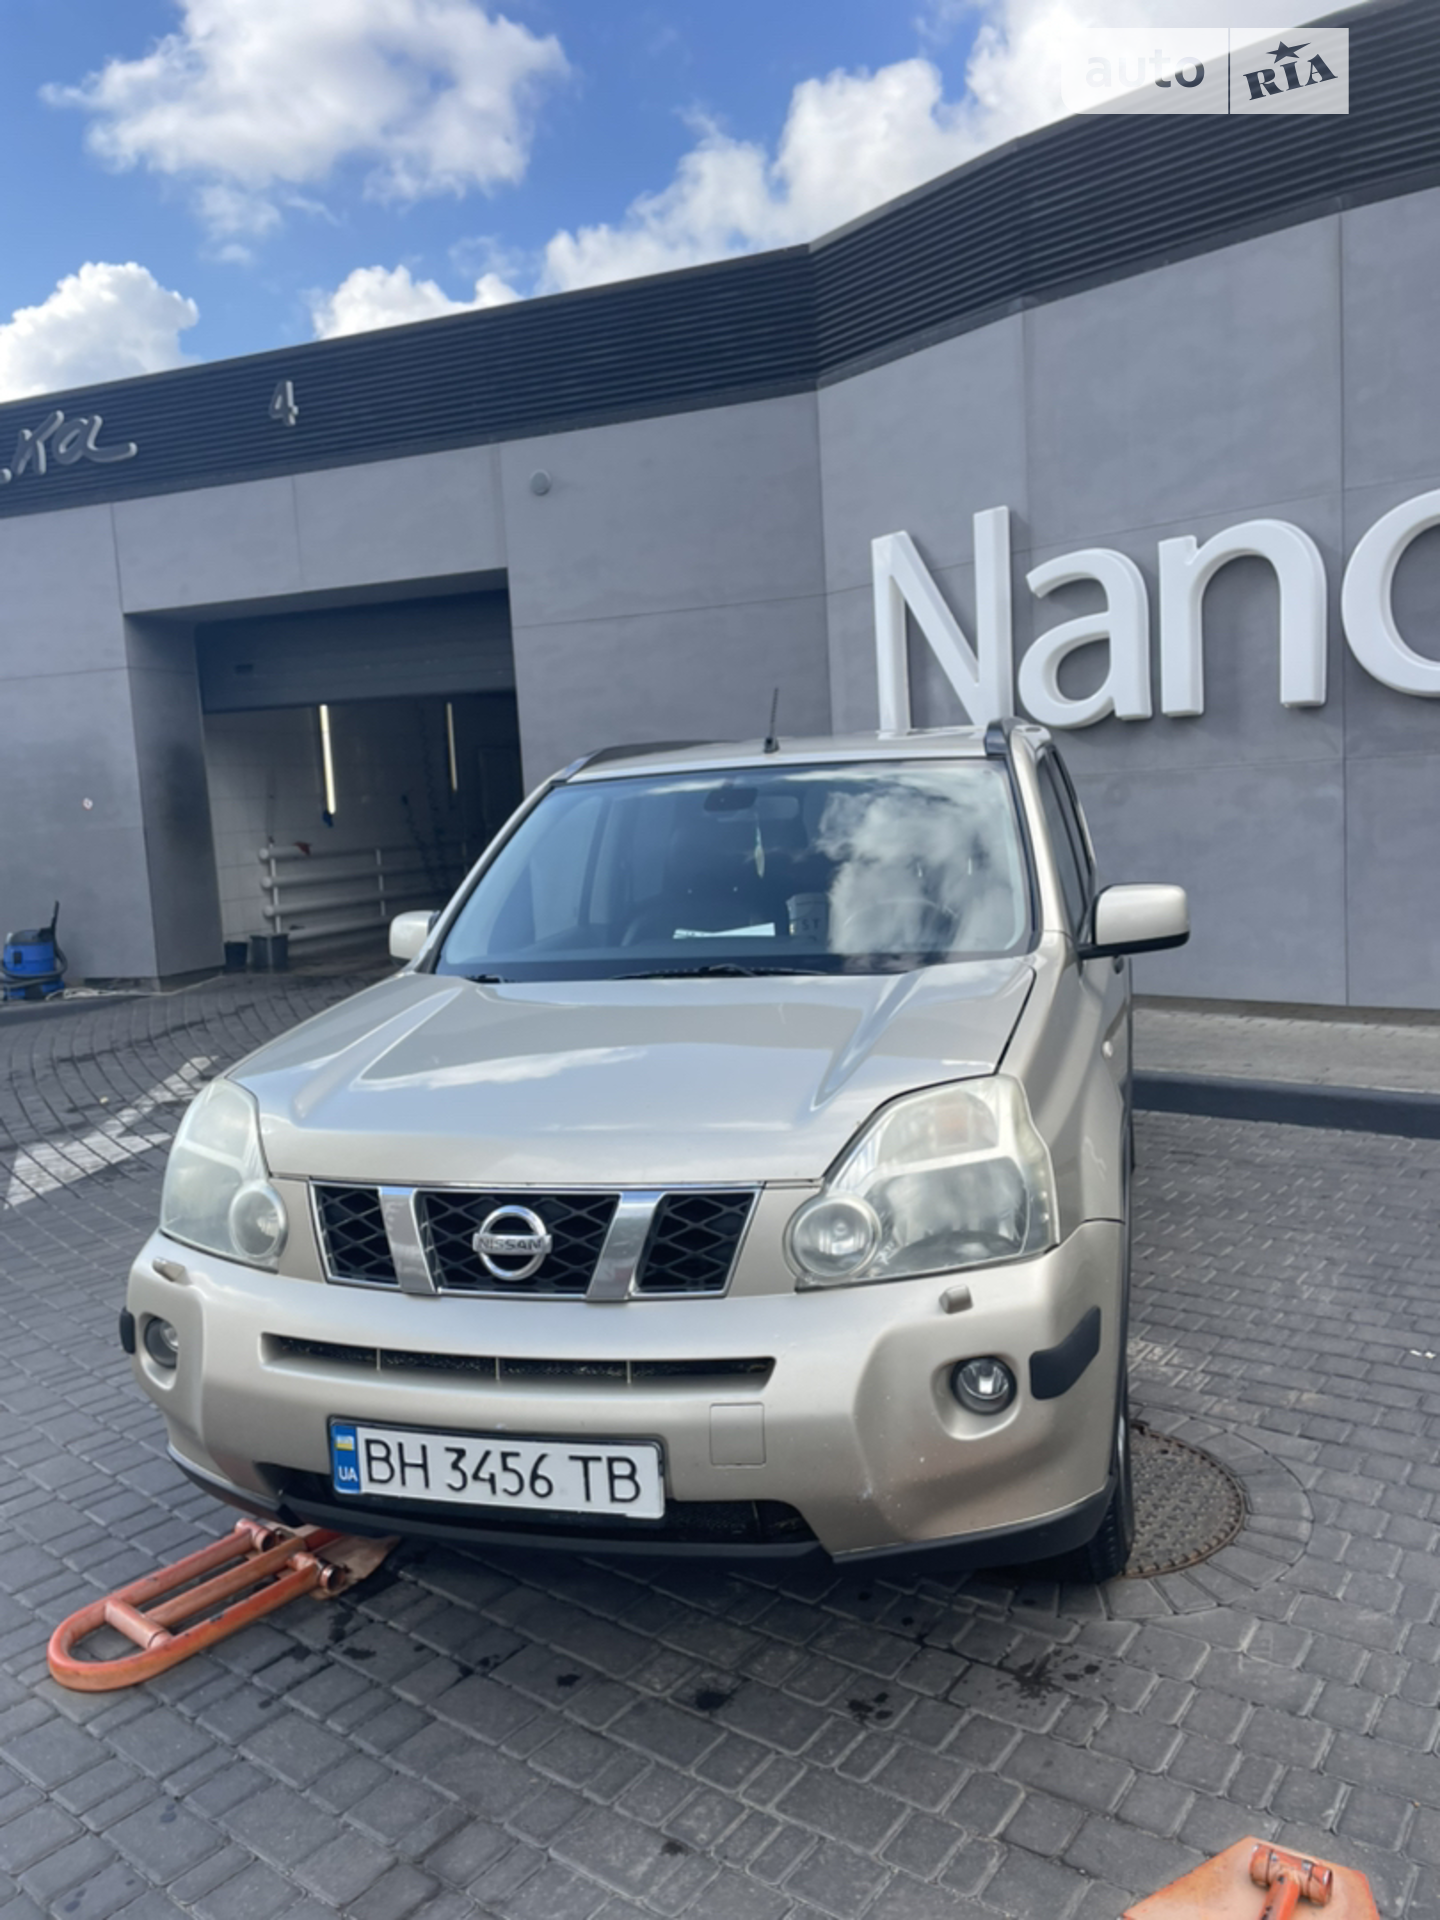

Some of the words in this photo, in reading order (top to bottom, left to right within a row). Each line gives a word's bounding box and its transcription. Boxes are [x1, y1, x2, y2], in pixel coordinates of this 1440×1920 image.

[269, 380, 299, 426] 4
[480, 1239, 542, 1251] NISSAN
[338, 1465, 358, 1482] UA
[365, 1439, 429, 1489] BH
[444, 1446, 553, 1499] 3456
[568, 1455, 641, 1503] TB
